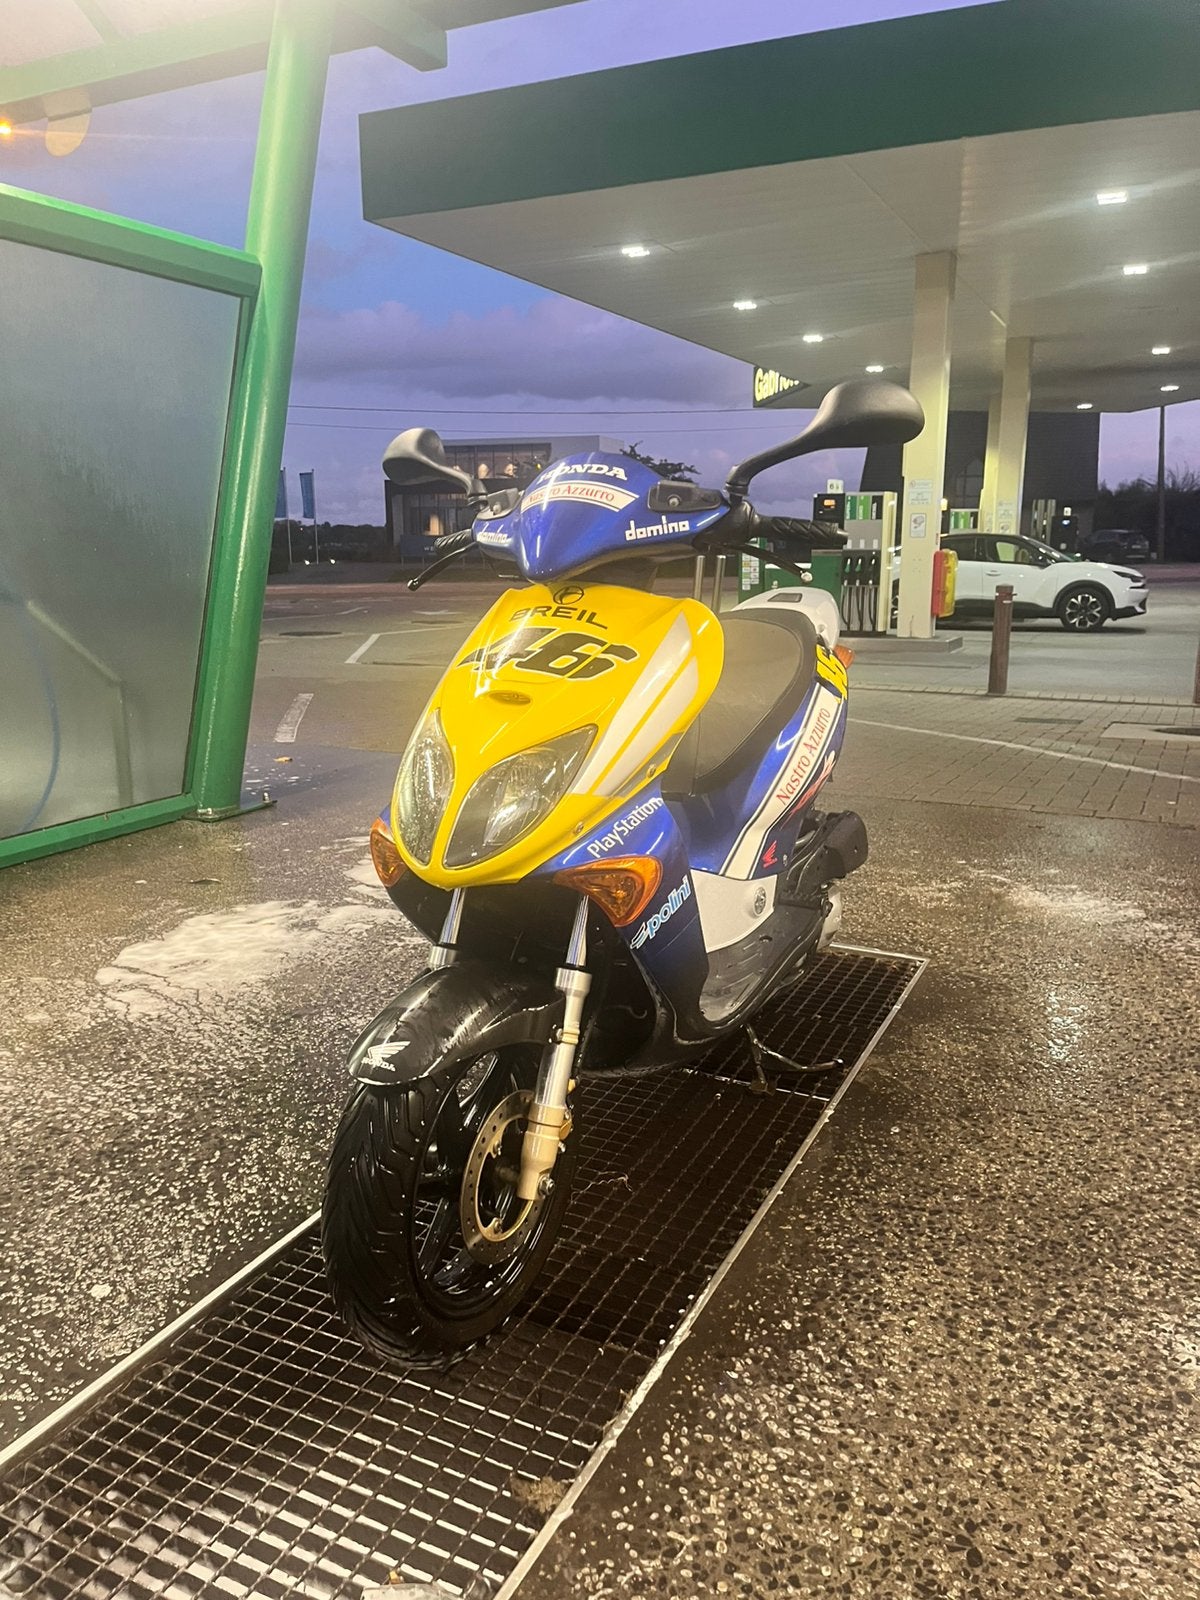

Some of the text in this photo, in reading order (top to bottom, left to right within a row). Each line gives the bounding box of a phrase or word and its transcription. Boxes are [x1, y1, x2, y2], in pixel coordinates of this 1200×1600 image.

[529, 485, 615, 503] Nasro Azzurro
[536, 463, 628, 485] HONDA
[625, 515, 690, 541] domino
[509, 605, 608, 630] BREIL
[456, 626, 639, 680] 46
[776, 707, 831, 806] Nastro Azzurro
[586, 797, 664, 859] PlayStation
[646, 874, 691, 940] polini
